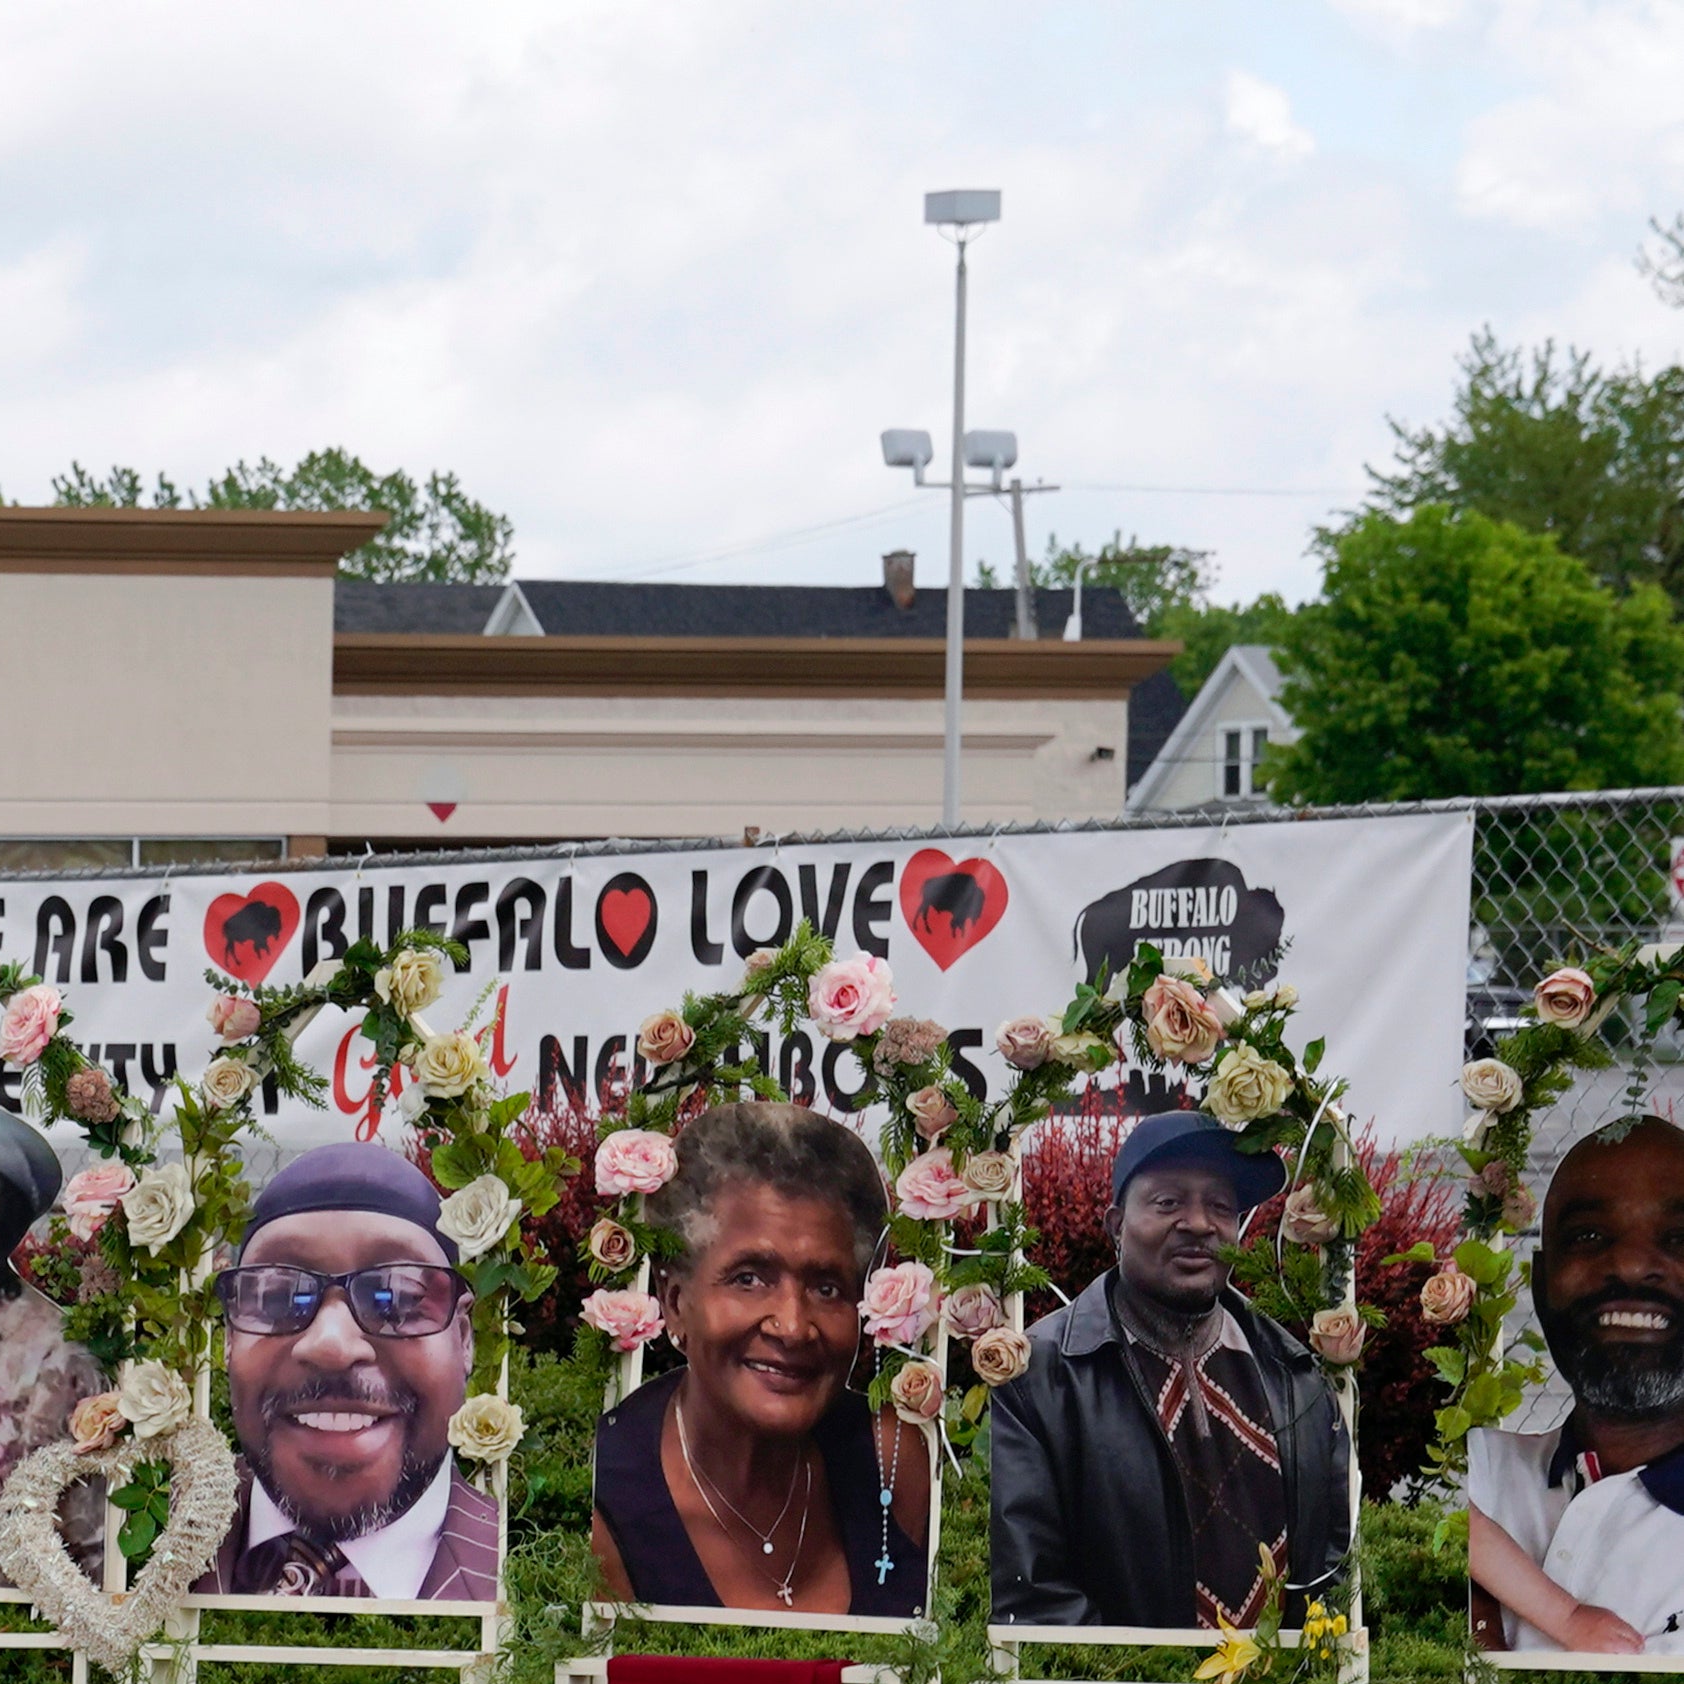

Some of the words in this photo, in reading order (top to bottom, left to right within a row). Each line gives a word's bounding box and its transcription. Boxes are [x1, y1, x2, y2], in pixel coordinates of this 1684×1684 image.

[33, 894, 171, 983] ARE
[302, 872, 658, 978] BUFFALO
[691, 861, 894, 965] LOVE
[1129, 885, 1238, 929] BUFFALO
[1134, 935, 1231, 977] RONG
[334, 984, 518, 1142] Gd
